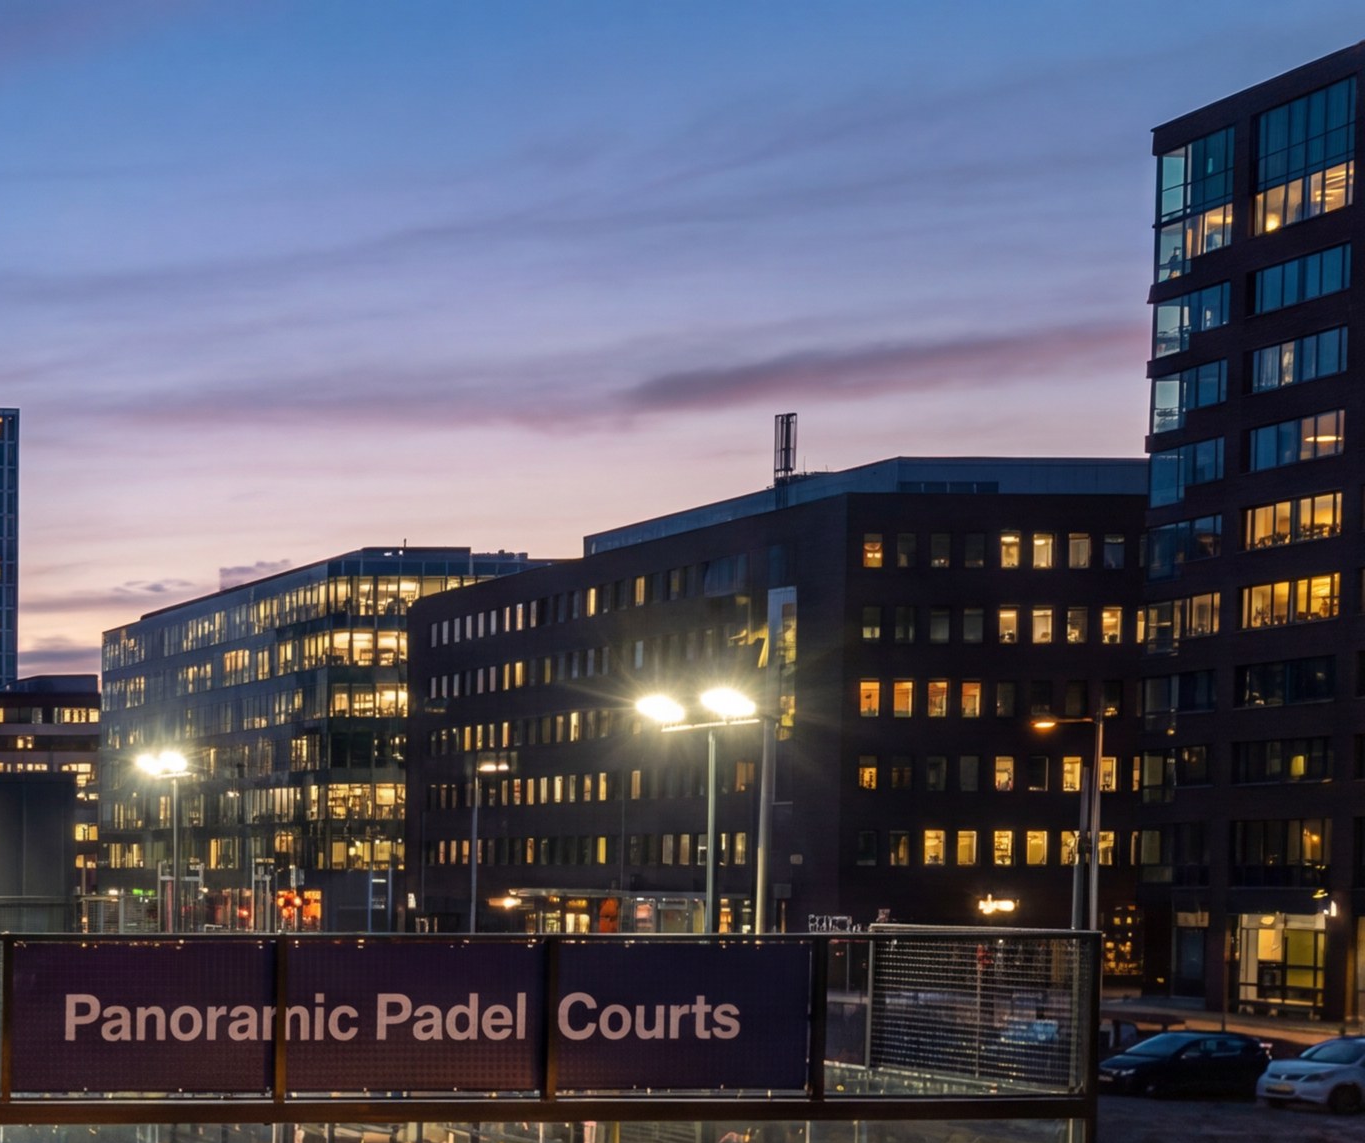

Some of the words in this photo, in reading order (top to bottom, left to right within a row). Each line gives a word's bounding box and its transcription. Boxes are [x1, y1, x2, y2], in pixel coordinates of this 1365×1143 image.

[63, 992, 360, 1043] Panoramic
[375, 991, 528, 1042] Padel
[557, 991, 742, 1042] Courts
